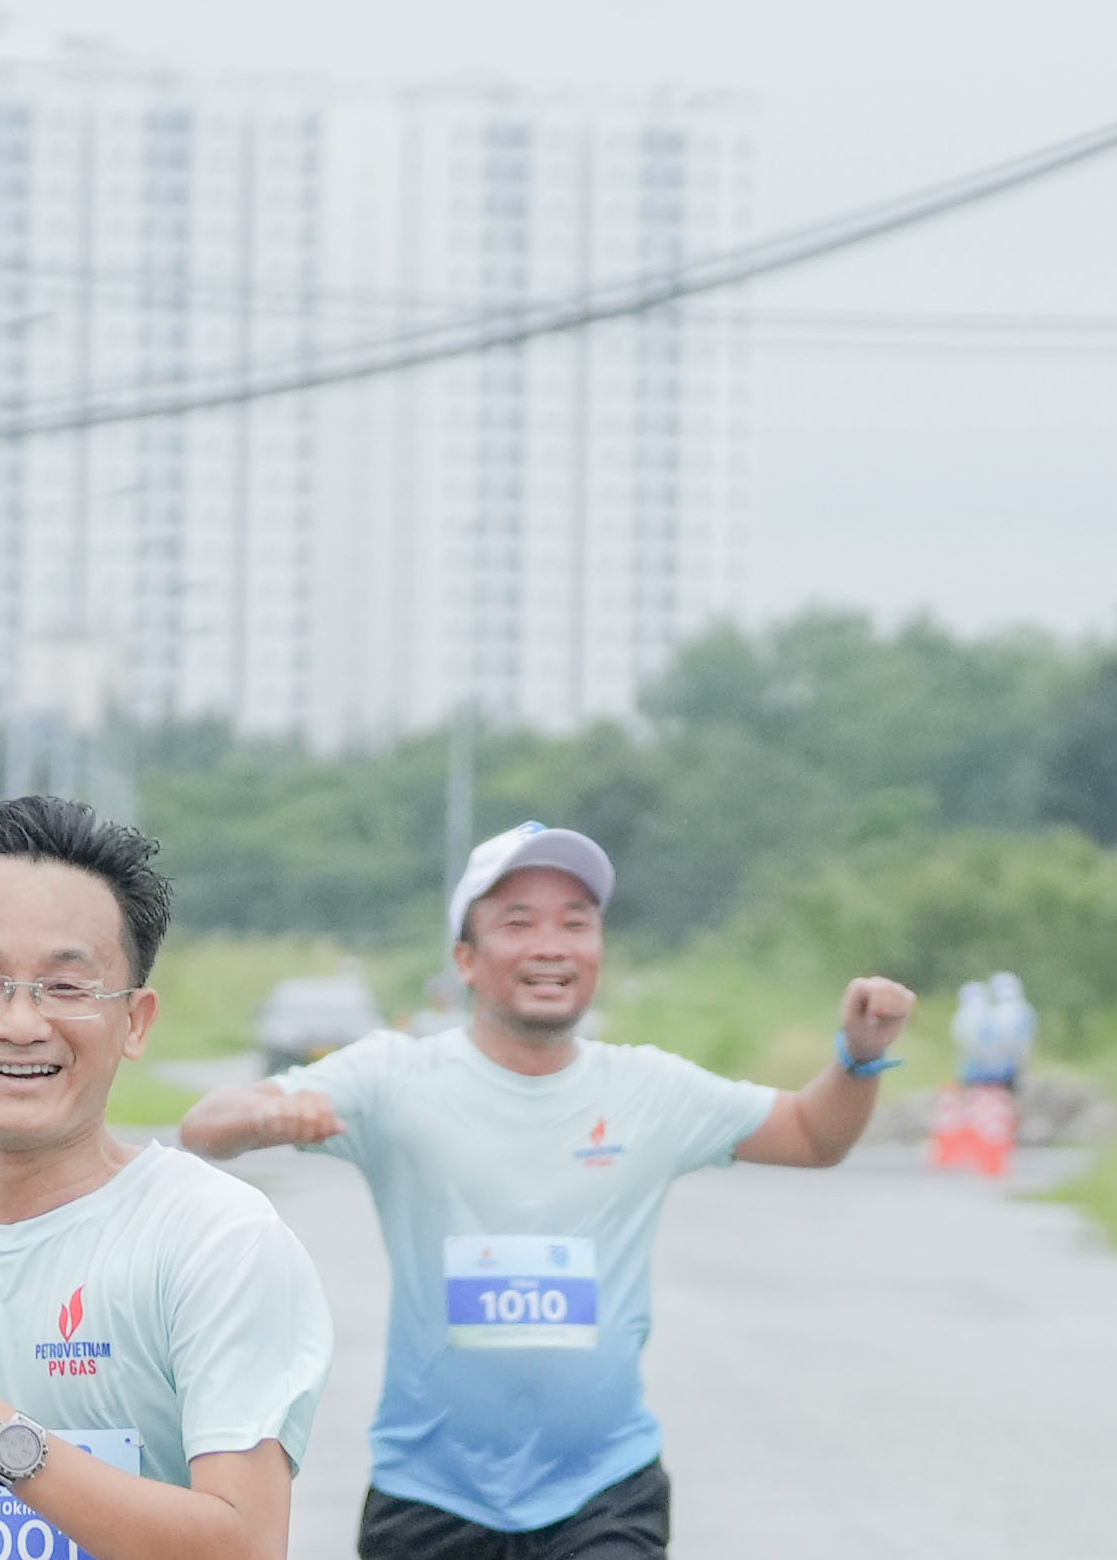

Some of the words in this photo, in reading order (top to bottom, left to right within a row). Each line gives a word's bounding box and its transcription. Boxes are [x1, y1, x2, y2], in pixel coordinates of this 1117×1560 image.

[479, 1289, 568, 1322] 1010
[49, 1360, 65, 1377] PV
[69, 1359, 96, 1376] GAS
